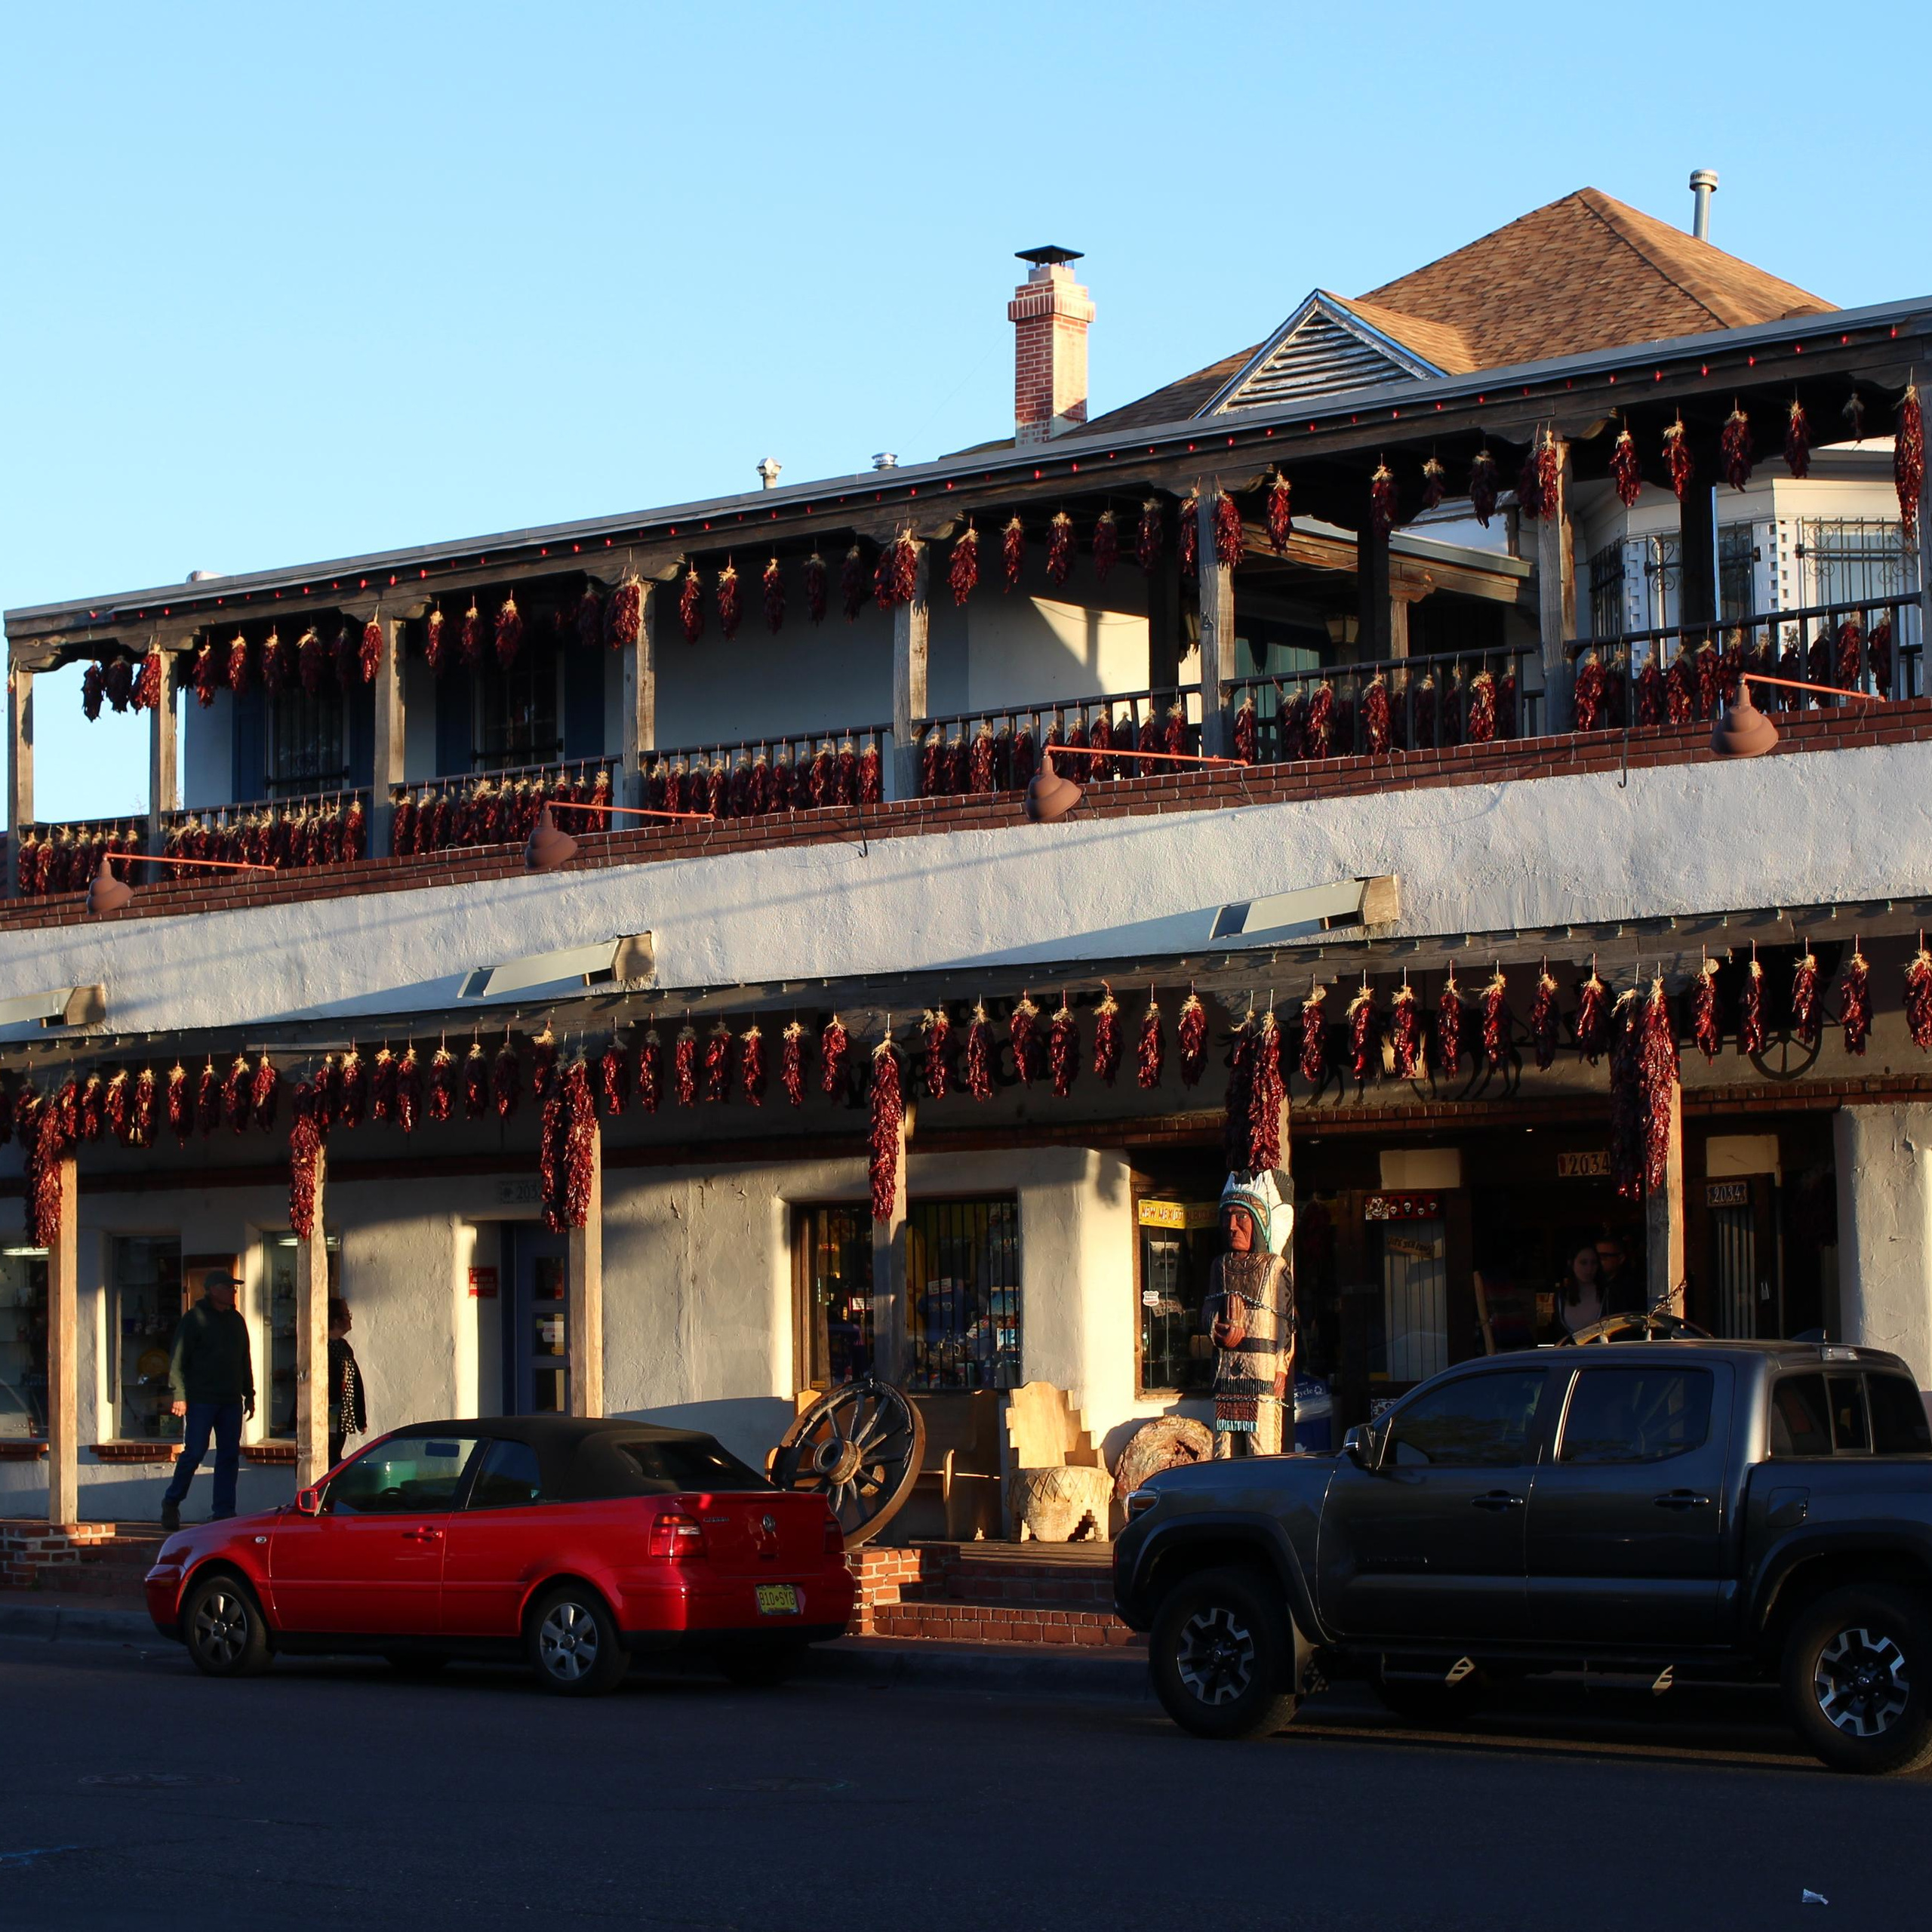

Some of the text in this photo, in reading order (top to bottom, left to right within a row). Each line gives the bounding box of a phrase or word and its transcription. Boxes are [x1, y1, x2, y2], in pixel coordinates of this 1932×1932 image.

[1569, 1153, 1611, 1174] 2034
[516, 1185, 540, 1200] 203
[1714, 1186, 1740, 1202] 2034
[1142, 1205, 1183, 1221] NEW MEXICO
